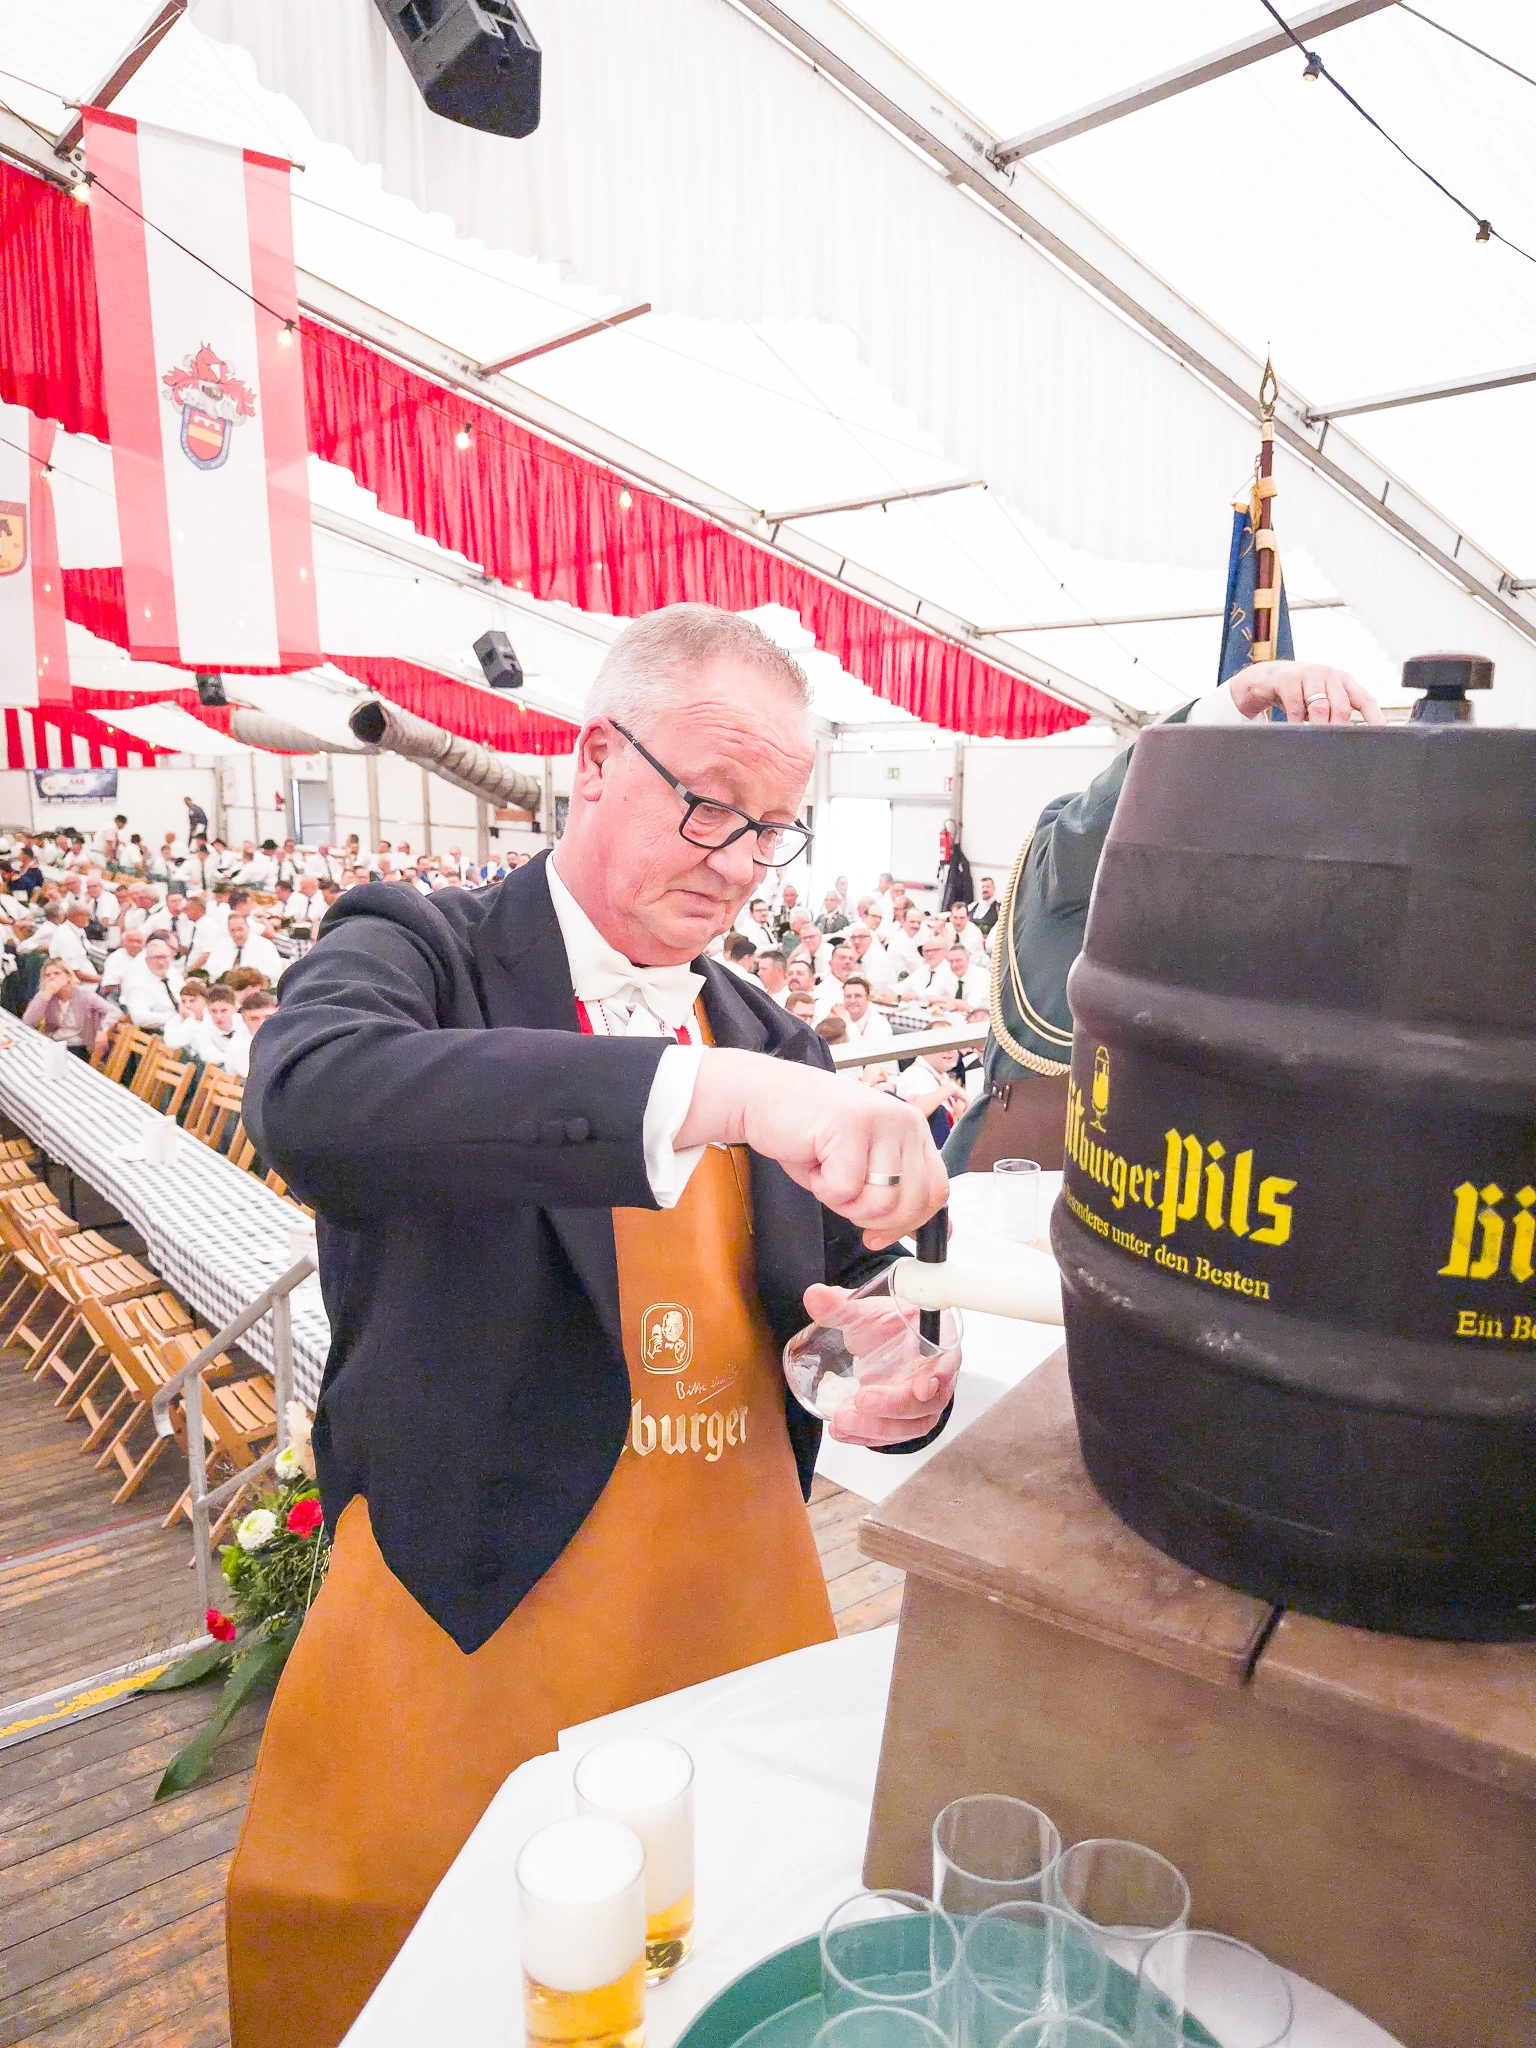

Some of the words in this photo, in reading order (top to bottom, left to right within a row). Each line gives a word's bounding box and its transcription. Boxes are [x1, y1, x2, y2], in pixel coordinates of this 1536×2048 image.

[1157, 1127, 1298, 1247] Pils
[1111, 1226, 1152, 1258] unter
[1154, 1243, 1190, 1275] den
[1194, 1256, 1270, 1300] Besten
[1437, 1181, 1536, 1283] Bi
[1456, 1310, 1504, 1338] Ein
[622, 1398, 748, 1462] burger
